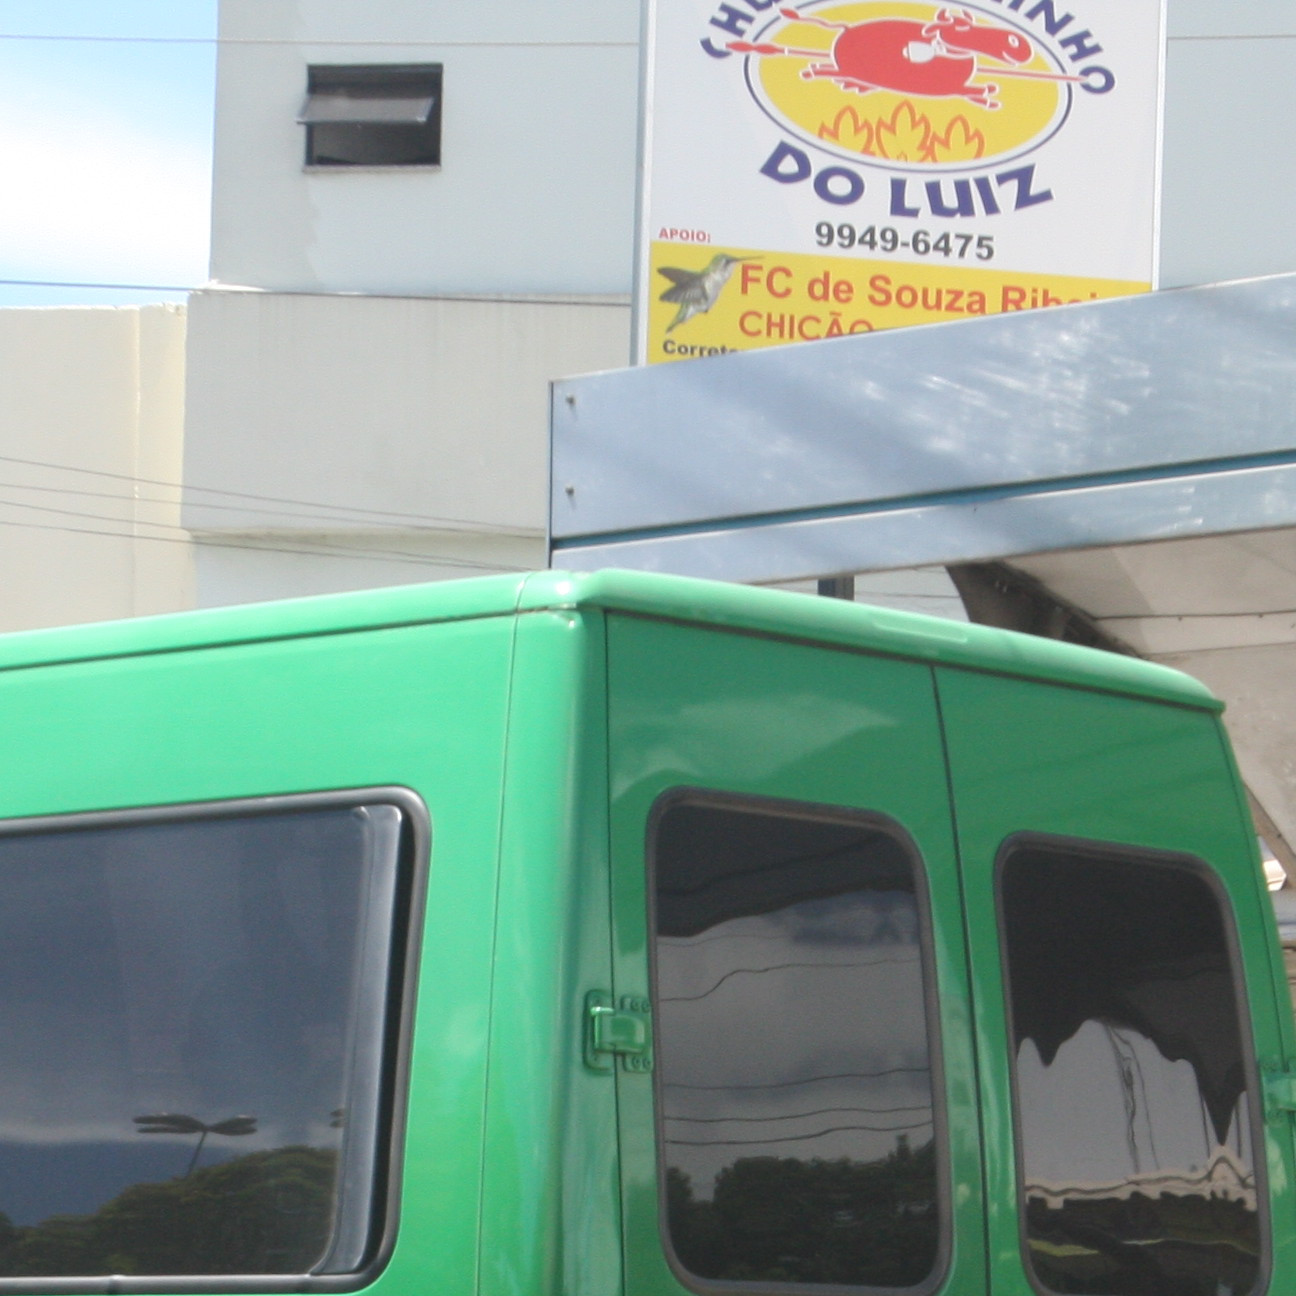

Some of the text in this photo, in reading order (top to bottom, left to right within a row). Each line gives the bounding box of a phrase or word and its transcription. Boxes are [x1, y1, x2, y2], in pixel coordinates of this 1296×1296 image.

[760, 140, 1054, 218] DO LUIZ
[658, 226, 711, 243] APOIO:
[814, 220, 995, 260] 9949-6475
[739, 263, 793, 299] FC
[807, 270, 854, 304] de
[867, 274, 987, 314] Souza
